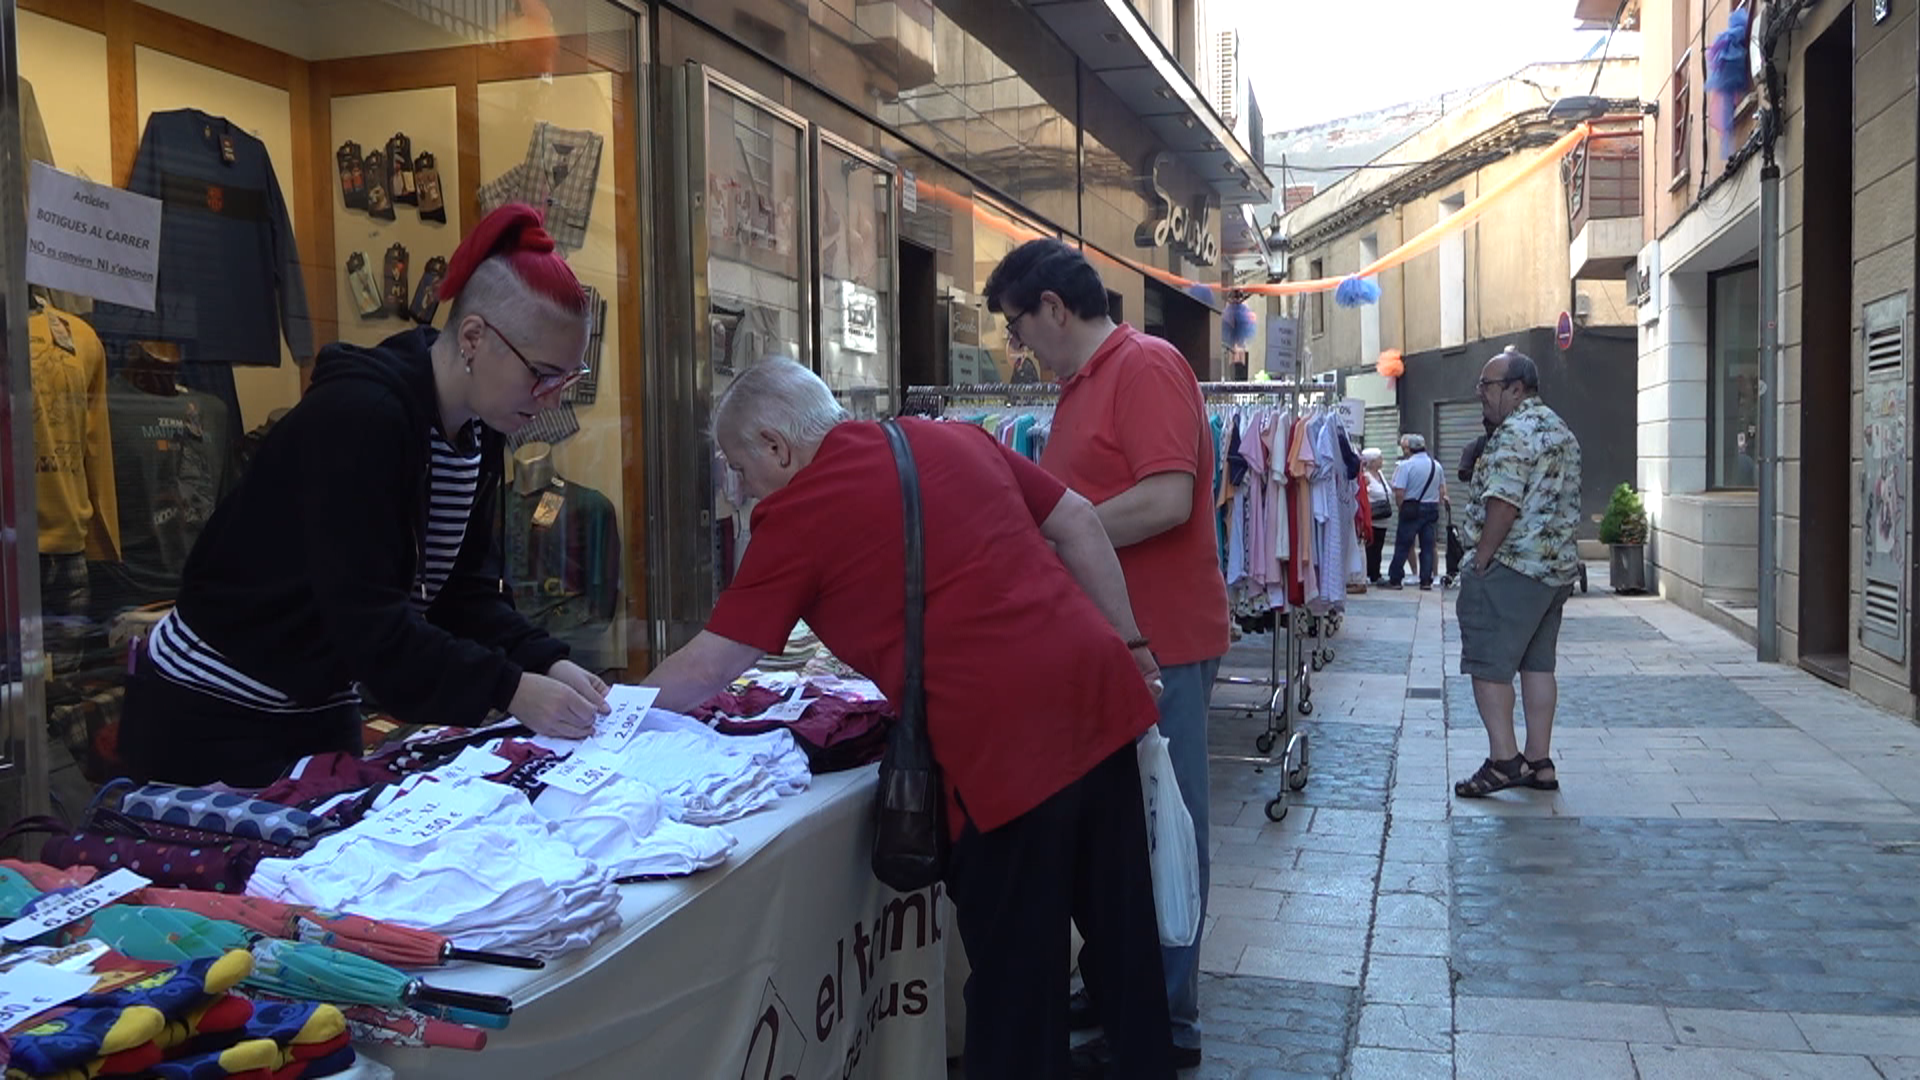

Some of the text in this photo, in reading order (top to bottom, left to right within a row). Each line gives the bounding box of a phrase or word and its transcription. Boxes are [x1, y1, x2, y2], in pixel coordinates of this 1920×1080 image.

[73, 191, 110, 211] Articles
[36, 207, 150, 250] BOTIGUES AL CARRER
[29, 238, 46, 254] NO
[46, 246, 56, 256] es
[96, 258, 109, 271] NI
[614, 713, 639, 739] 2,90
[816, 937, 844, 1043] el
